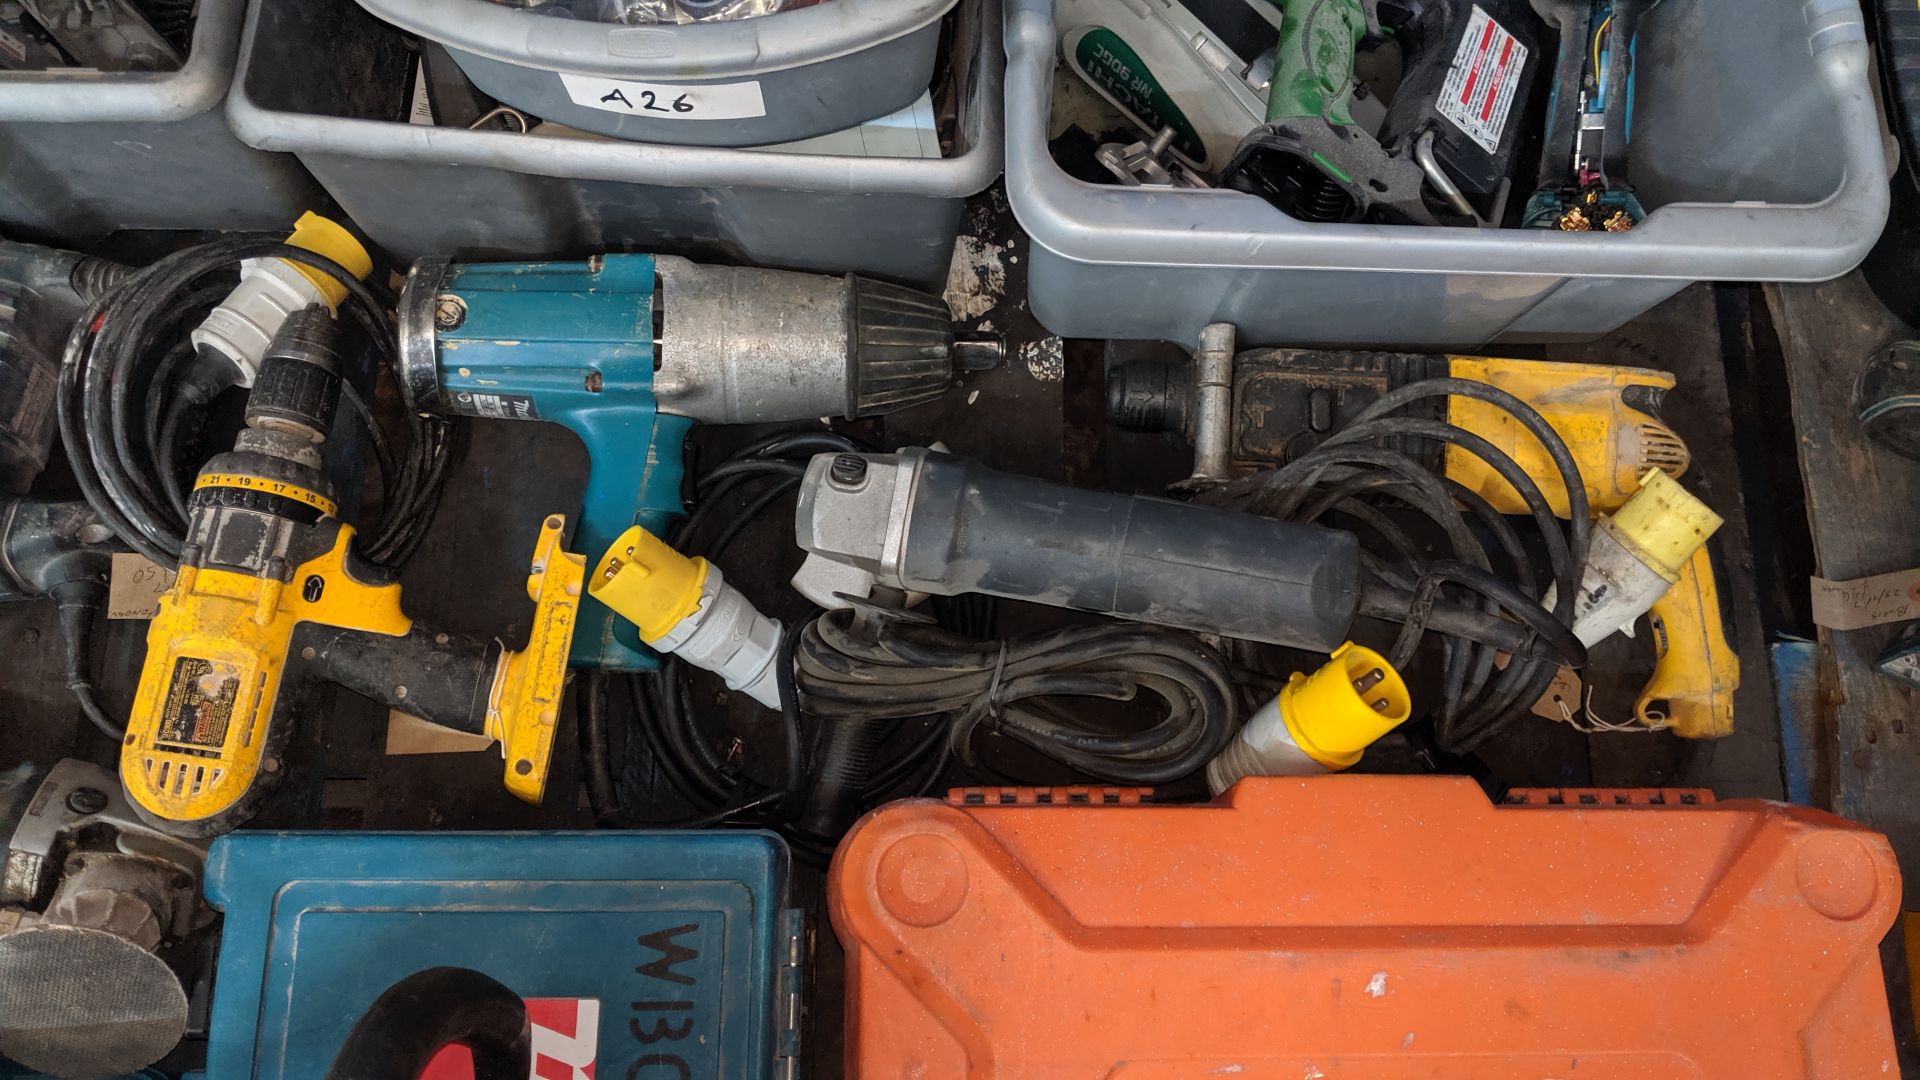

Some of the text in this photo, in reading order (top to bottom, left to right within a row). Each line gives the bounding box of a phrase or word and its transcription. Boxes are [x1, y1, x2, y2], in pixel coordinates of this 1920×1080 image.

[600, 88, 695, 112] A26
[1131, 76, 1153, 99] NR
[210, 475, 221, 484] 21
[238, 477, 252, 486] 19
[273, 483, 287, 492] 17
[304, 493, 316, 503] 15
[196, 702, 211, 734] WARNING
